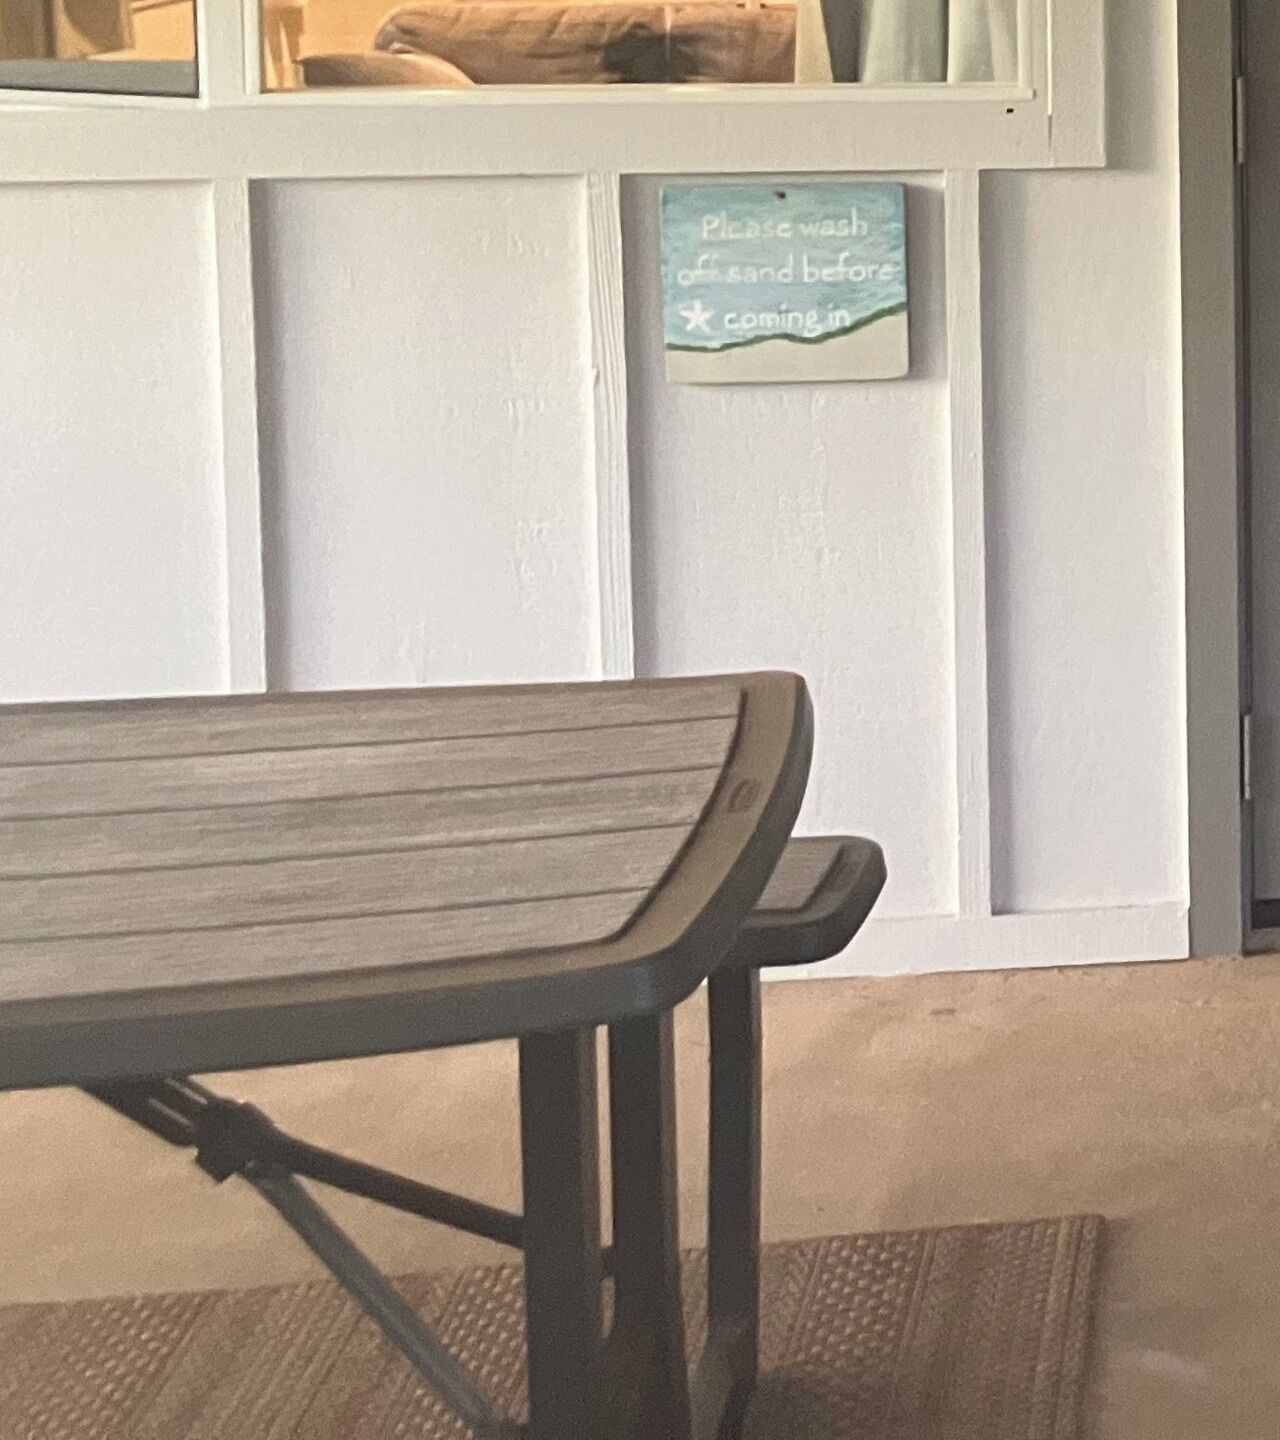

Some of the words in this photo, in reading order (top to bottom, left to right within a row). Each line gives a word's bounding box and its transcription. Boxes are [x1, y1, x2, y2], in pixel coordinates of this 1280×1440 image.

[702, 211, 794, 240] Please
[800, 207, 868, 238] wash
[677, 253, 723, 287] off
[725, 254, 794, 284] sand
[802, 251, 894, 283] before
[724, 302, 823, 337] coming
[826, 302, 851, 327] in
